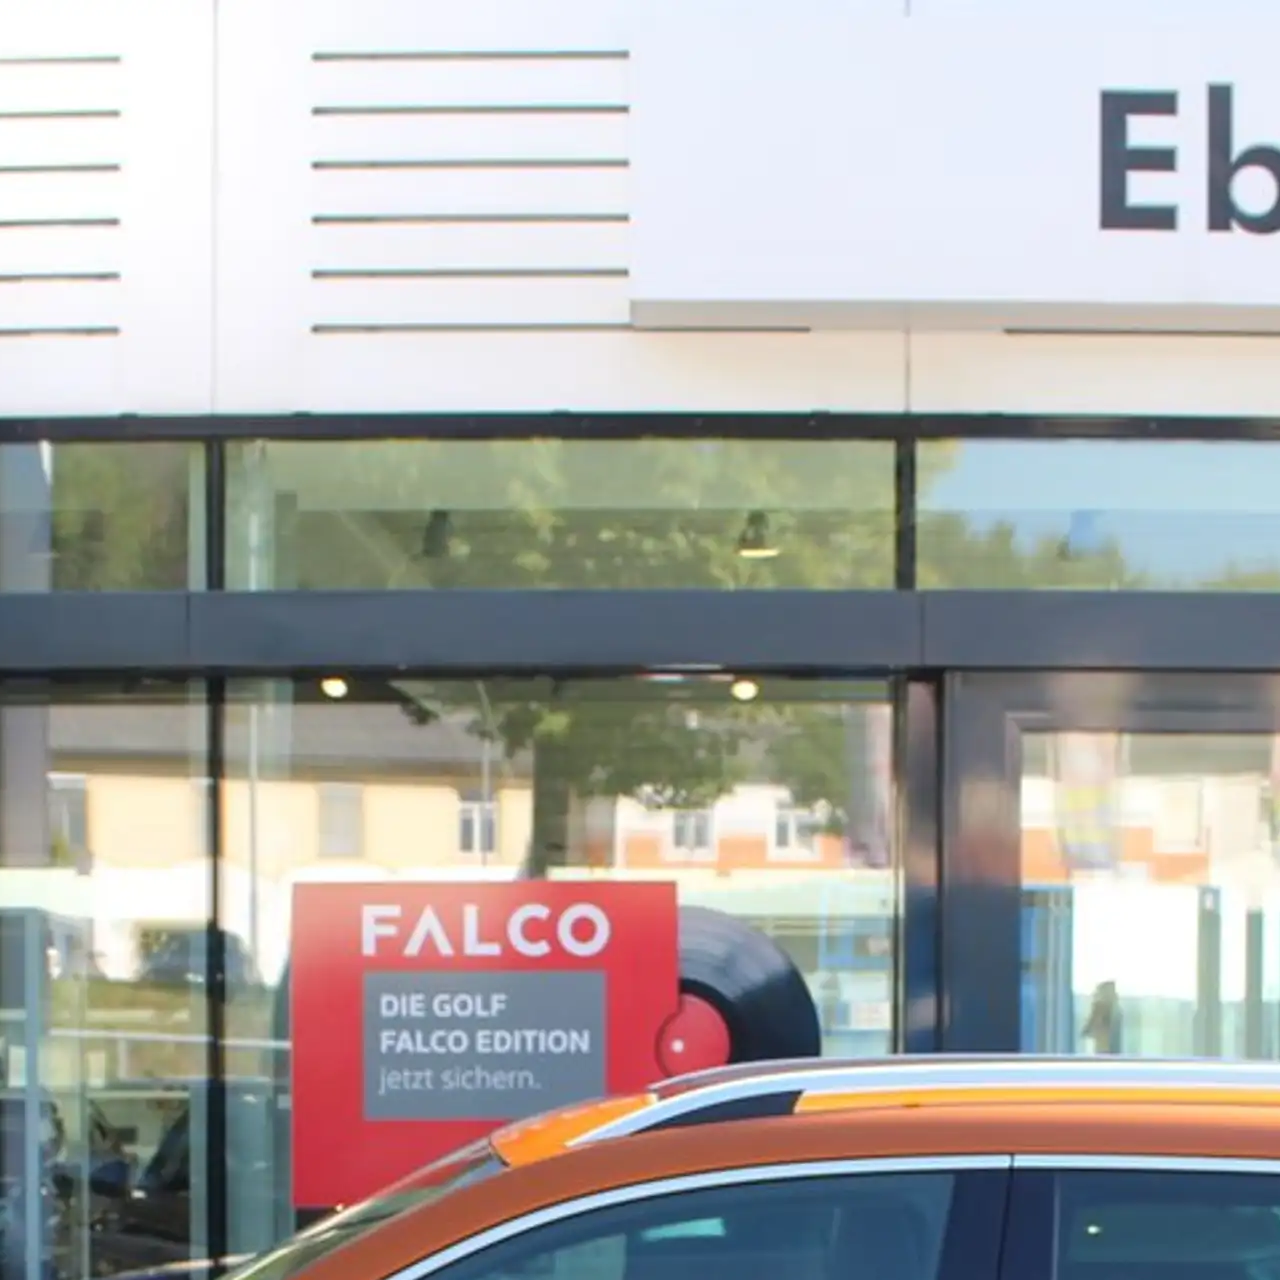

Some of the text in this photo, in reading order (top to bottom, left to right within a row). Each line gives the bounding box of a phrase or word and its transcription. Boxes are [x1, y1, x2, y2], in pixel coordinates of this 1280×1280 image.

[361, 902, 611, 957] FALCO
[379, 993, 508, 1018] DIE GOLF
[379, 1029, 591, 1054] FALCO EDITION
[378, 1065, 542, 1095] jetzt sichern.
